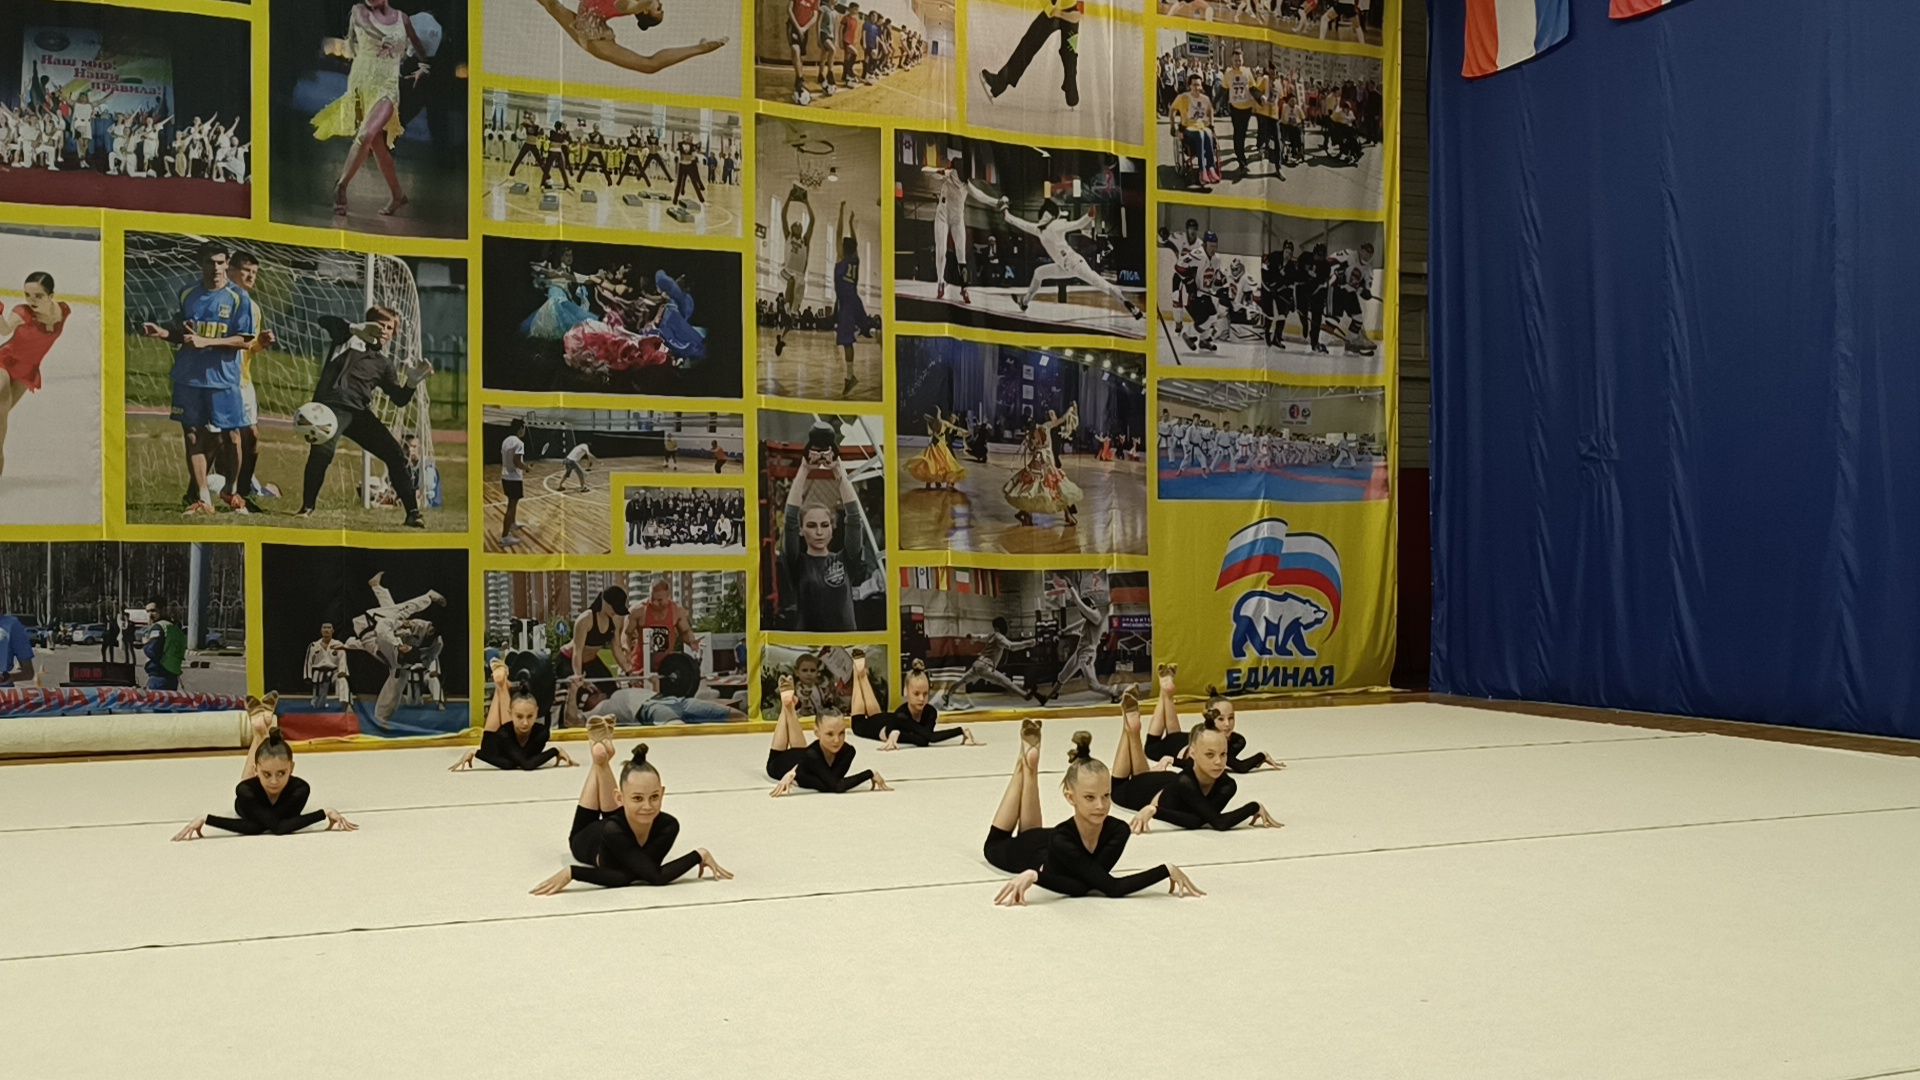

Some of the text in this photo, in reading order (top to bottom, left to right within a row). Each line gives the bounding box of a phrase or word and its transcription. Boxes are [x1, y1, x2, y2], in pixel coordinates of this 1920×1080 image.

[40, 55, 117, 71] Наш мир!
[73, 68, 119, 81] Наши
[91, 82, 162, 95] правила!
[1226, 665, 1335, 690] ЕДИНАЯ
